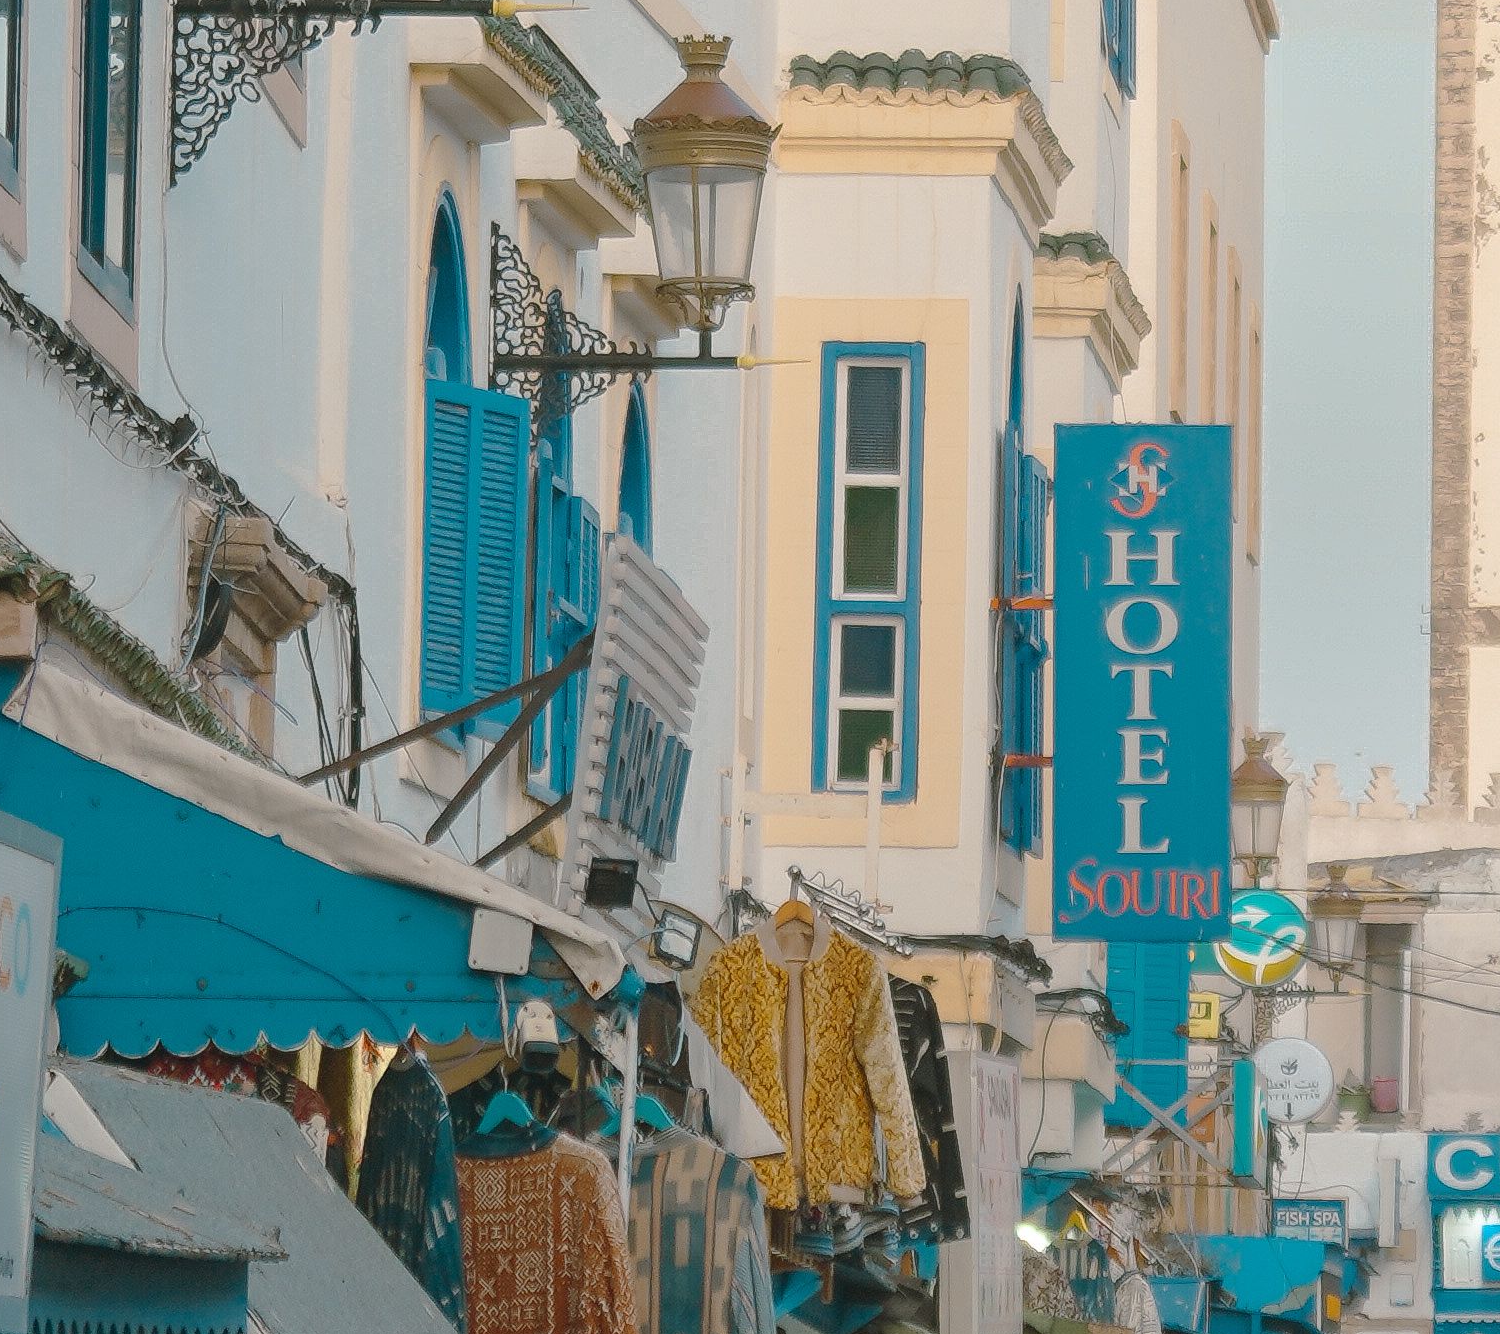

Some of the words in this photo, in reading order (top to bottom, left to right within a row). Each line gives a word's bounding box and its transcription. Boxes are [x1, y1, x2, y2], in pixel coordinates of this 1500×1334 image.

[1102, 528, 1181, 855] HOTEL
[1058, 857, 1222, 924] SOUIRI
[1276, 1211, 1310, 1226] FISH
[1313, 1211, 1341, 1226] SPA
